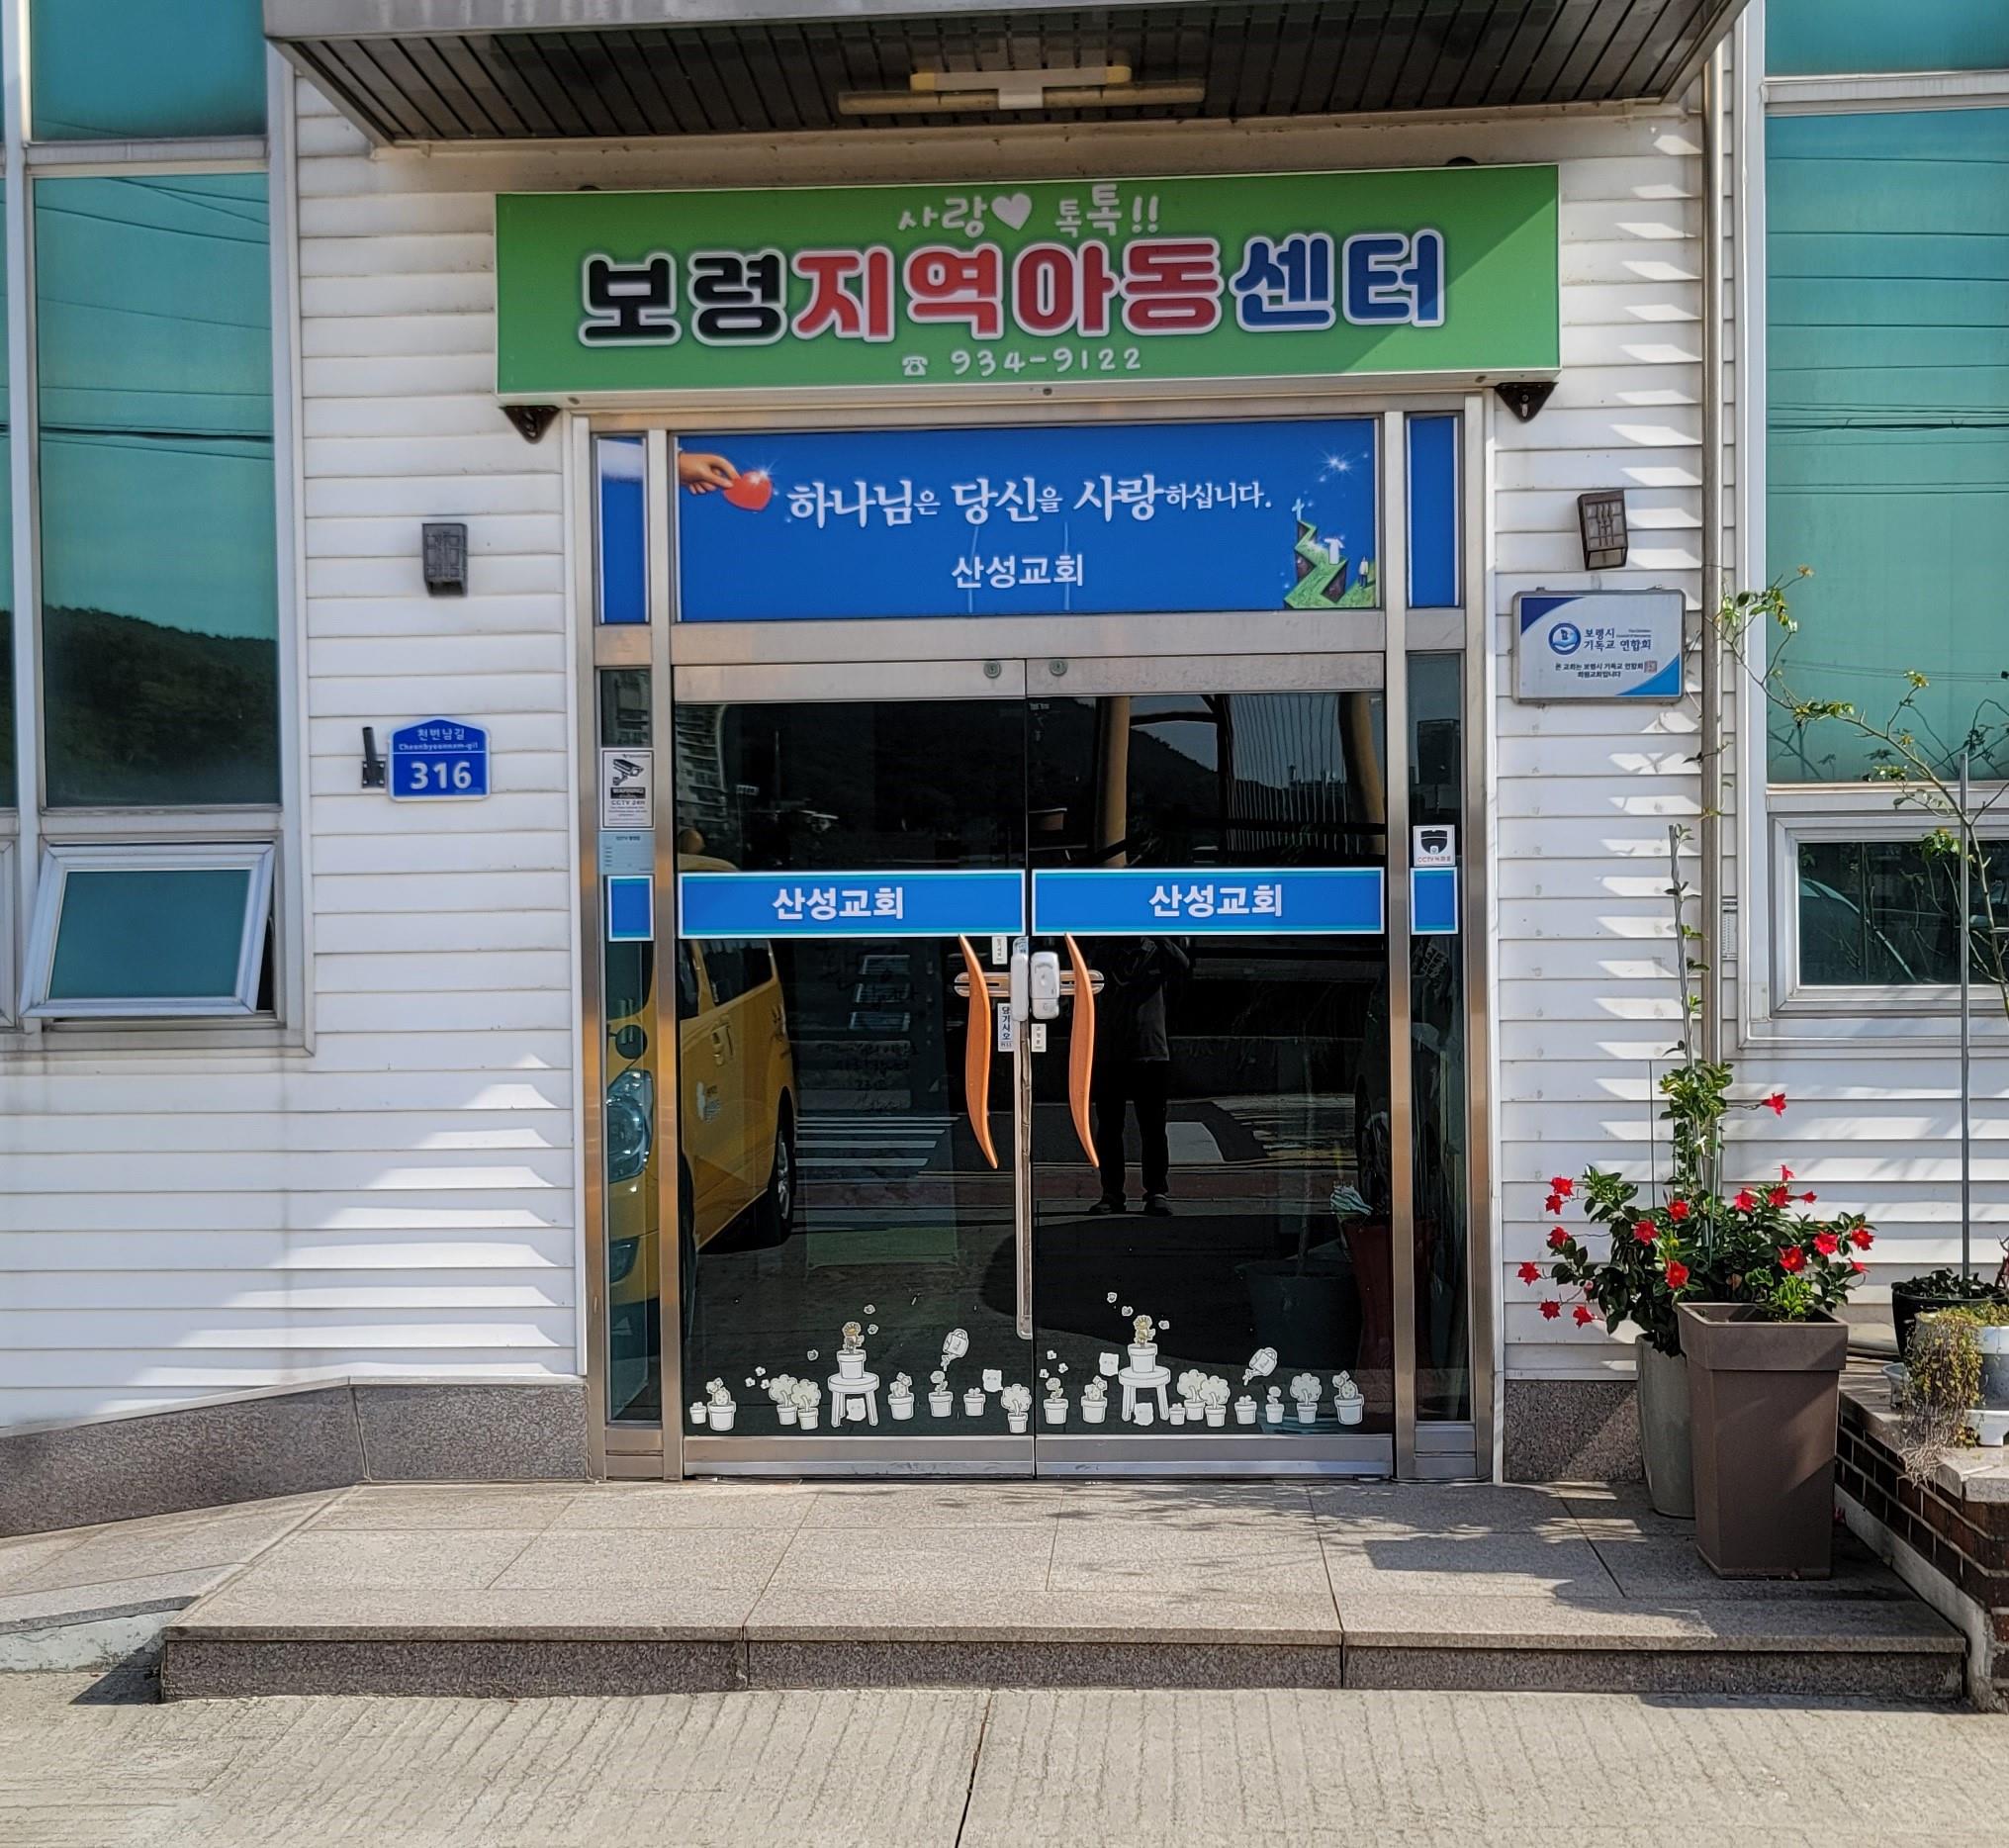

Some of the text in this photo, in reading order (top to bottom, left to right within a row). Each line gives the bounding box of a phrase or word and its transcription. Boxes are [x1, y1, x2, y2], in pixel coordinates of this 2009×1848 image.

[897, 195, 988, 239] 사랑
[578, 227, 1447, 348] 보령지역아동센터
[951, 347, 1142, 378] 934-9122
[787, 480, 942, 528] 하나님은
[951, 475, 1063, 525] 당신을
[951, 552, 1085, 590] 산성교회
[1584, 627, 1615, 640] 보령시
[1584, 638, 1652, 652] 기독교 연합회
[410, 761, 473, 790] 316
[772, 886, 905, 921] 산성교회
[1148, 882, 1284, 919] 산성교회
